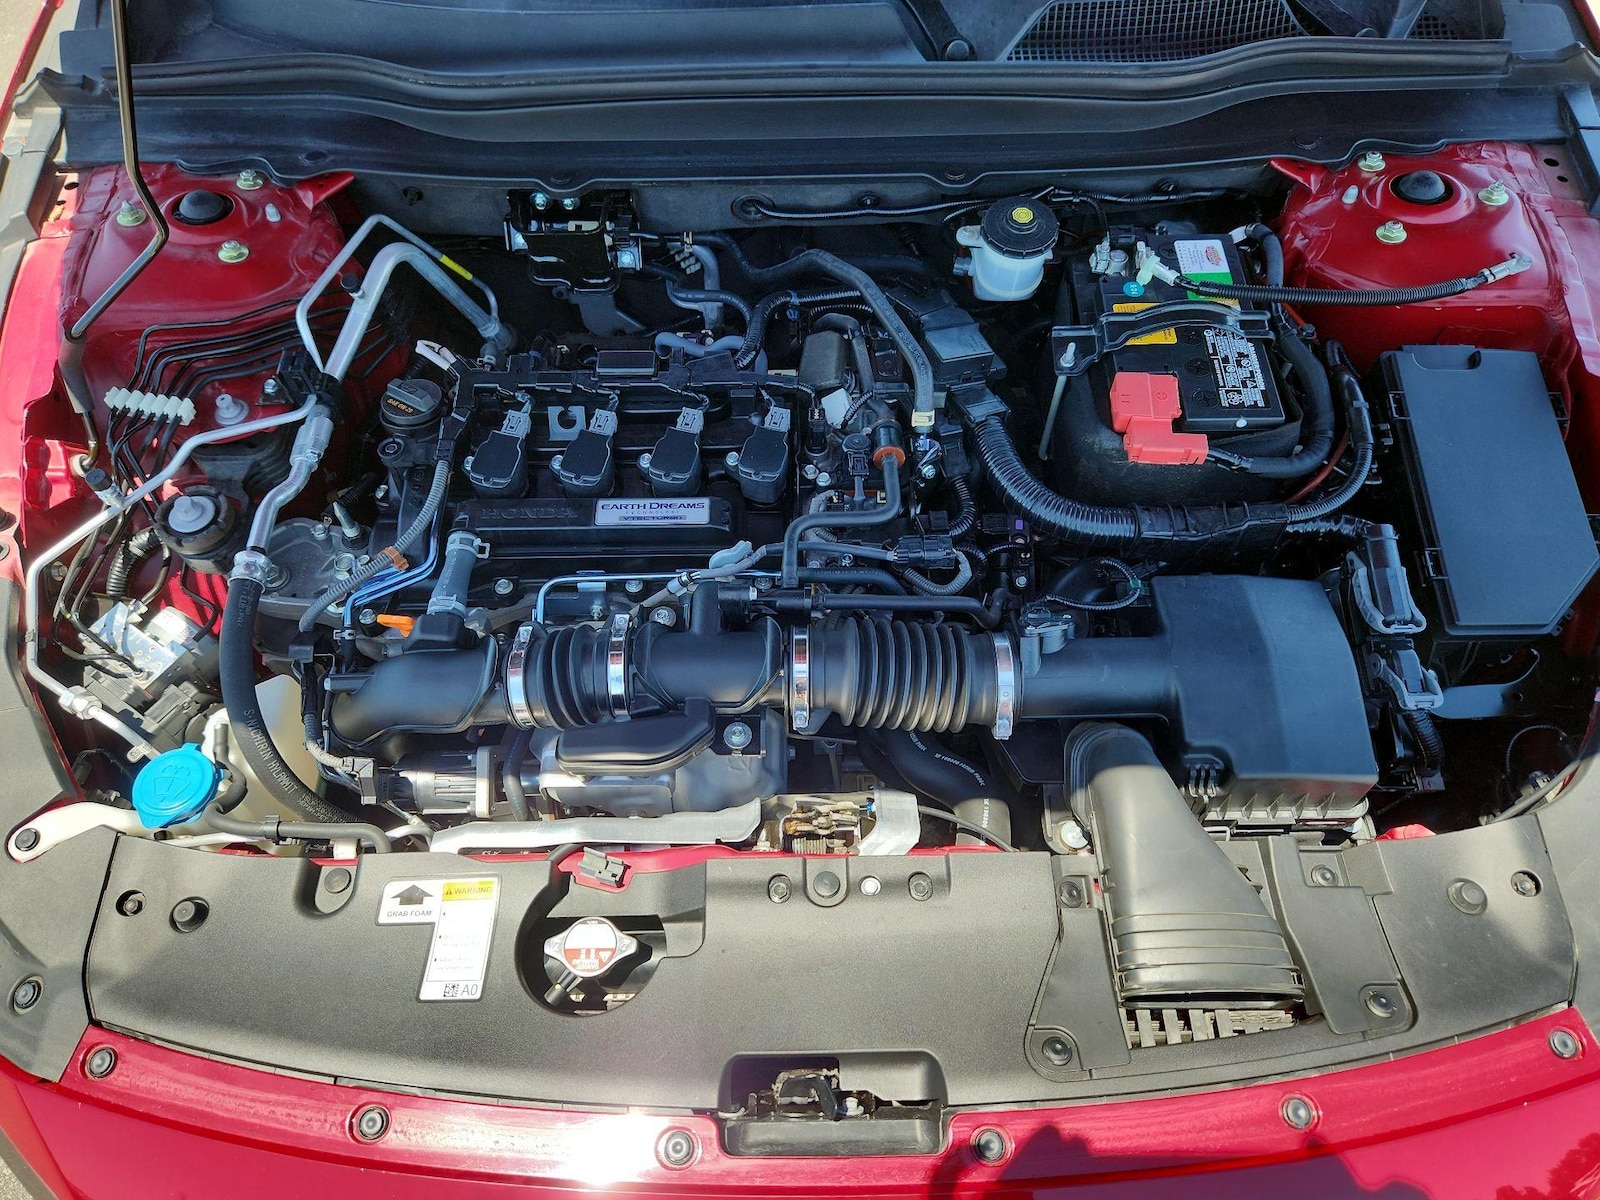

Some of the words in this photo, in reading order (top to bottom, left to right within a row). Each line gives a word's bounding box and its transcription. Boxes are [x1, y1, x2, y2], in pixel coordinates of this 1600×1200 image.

[649, 502, 705, 510] DREAMS
[480, 507, 579, 519] HONDA
[454, 886, 493, 895] WARNING
[387, 910, 409, 918] GRAB
